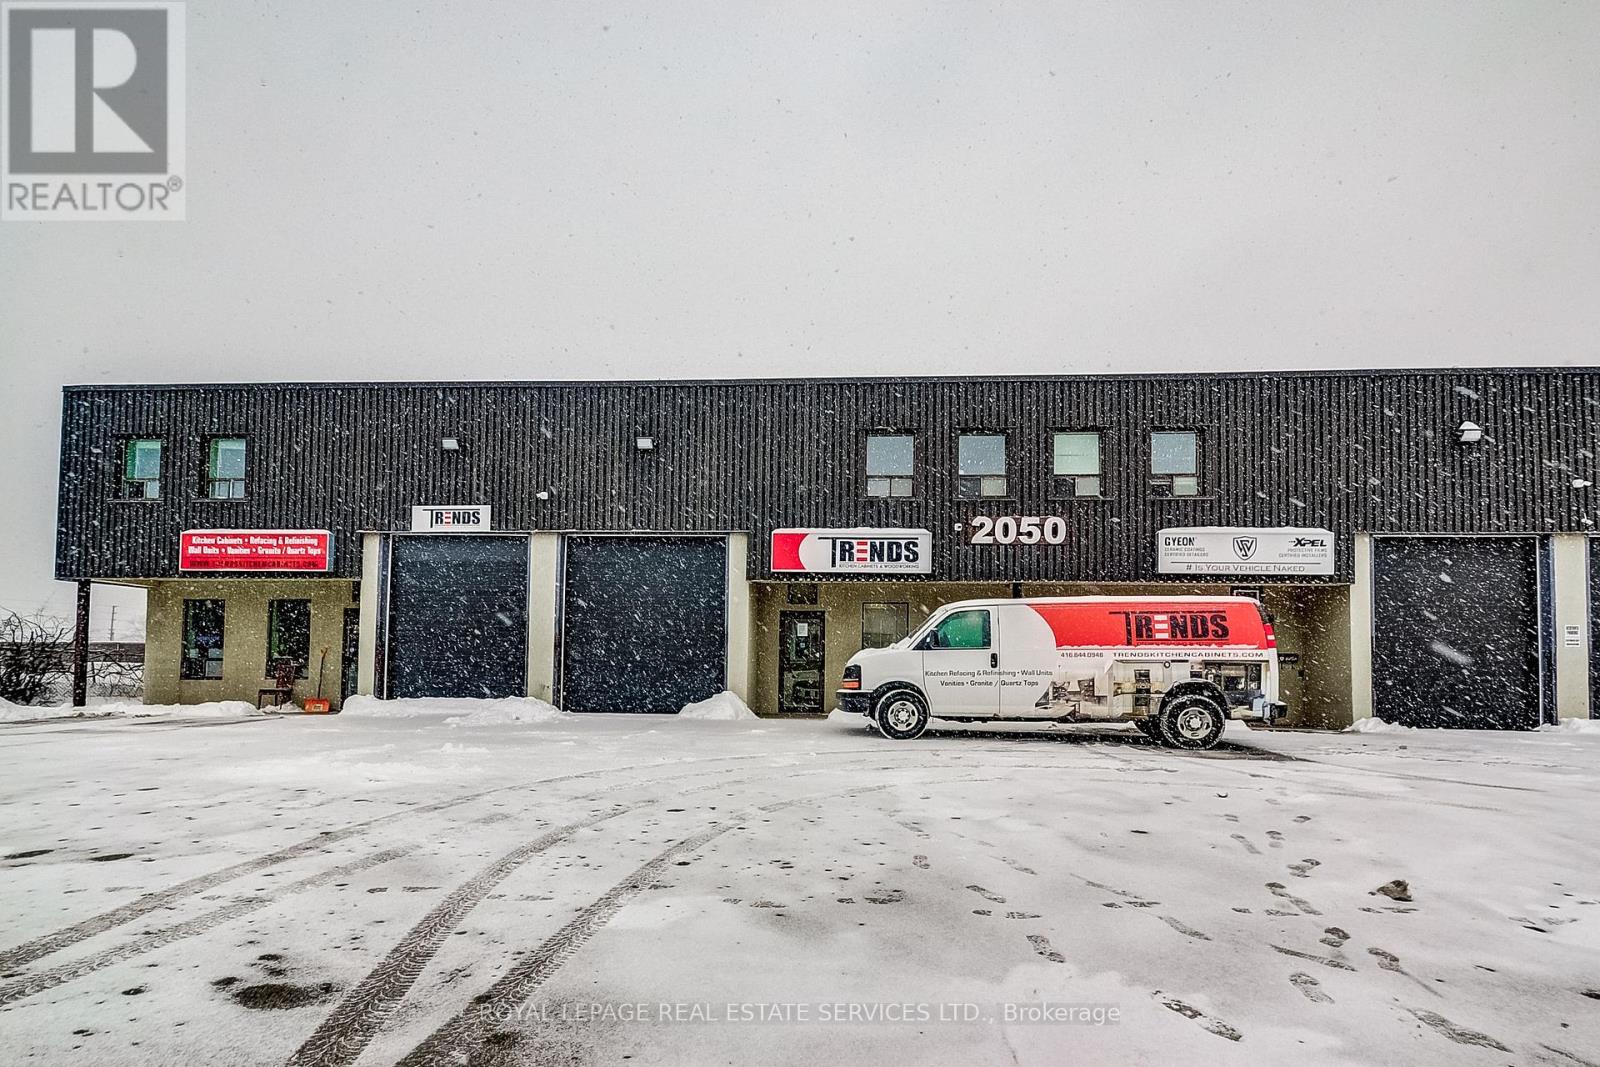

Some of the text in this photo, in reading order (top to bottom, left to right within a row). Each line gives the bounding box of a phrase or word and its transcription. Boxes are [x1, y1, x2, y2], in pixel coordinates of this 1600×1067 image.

[422, 508, 481, 528] TRENDS
[970, 516, 1067, 545] 2050
[250, 535, 277, 546] Refacing
[1165, 536, 1195, 547] GYEON
[1293, 537, 1327, 547] XPEL
[818, 537, 919, 568] TRENDS
[1109, 610, 1229, 645] TRENDS
[949, 670, 975, 678] Refacing
